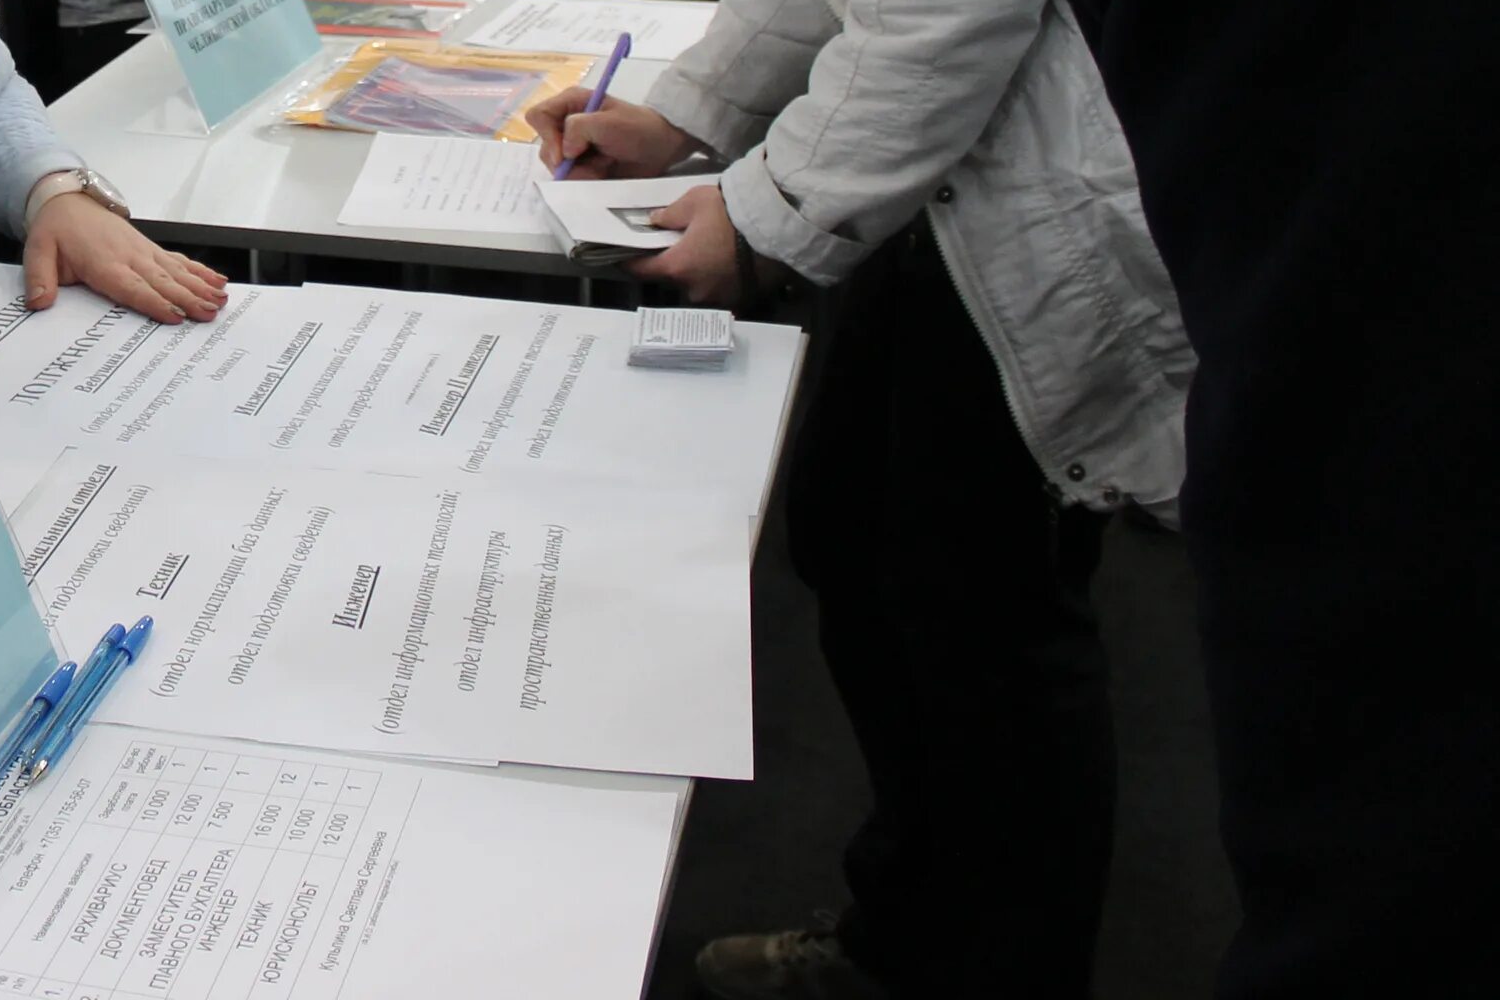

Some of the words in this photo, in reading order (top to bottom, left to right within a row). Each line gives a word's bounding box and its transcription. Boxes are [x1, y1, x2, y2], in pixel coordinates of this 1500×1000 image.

[74, 352, 125, 393] Ведущий
[118, 318, 159, 355] инжене
[234, 371, 282, 417] Инженер
[276, 321, 318, 368] категории
[418, 386, 464, 436] Инженер
[457, 333, 495, 382] категории
[116, 363, 196, 444] инфраструктуры
[268, 412, 306, 450] (отдел
[328, 418, 358, 449] отдел
[457, 437, 494, 474] (отдел
[480, 360, 534, 441] информационных
[539, 373, 579, 430] подготовки
[525, 426, 554, 460] отдел
[70, 463, 112, 506] отдела
[53, 538, 113, 614] подготовки
[107, 483, 155, 540] сведений)
[430, 488, 462, 563] технологий;
[532, 523, 571, 573] данных)
[136, 551, 184, 600] Техник
[148, 646, 198, 698] (отдел
[184, 550, 250, 650] нормализации
[231, 530, 261, 558] баз
[248, 486, 290, 535] данных;
[227, 638, 264, 687] отдел
[256, 559, 303, 645] подготовки
[297, 505, 337, 564] сведений)
[331, 564, 377, 631] Инженер
[462, 529, 513, 649] инфраструктуры
[390, 558, 441, 682] информационных
[519, 570, 559, 712] пространственных
[372, 677, 411, 736] (отдел
[452, 646, 484, 693] отдел
[140, 806, 157, 823] 10
[215, 800, 235, 823] 500
[280, 771, 299, 787] 12
[8, 851, 46, 894] Телефон
[40, 812, 69, 851] +7(351)
[173, 811, 190, 828] 12
[288, 826, 305, 842] 10
[322, 830, 340, 848] 12
[69, 862, 129, 944] АРХИВАРИУС
[99, 857, 172, 960] ДОКУМЕНТОВЕД
[138, 867, 199, 959] ЗАМЕСТИТЕЛЬ
[342, 875, 370, 925] Светлана
[357, 830, 388, 879] Сергеевна
[148, 921, 197, 992] ГЛАВНОГО
[193, 846, 236, 925] БУХГАЛТЕРА
[196, 888, 239, 952] ИНЖЕНЕР
[235, 899, 274, 952] ТЕХНИК
[260, 879, 320, 985] ЮРИСКОНСУЛЬТ
